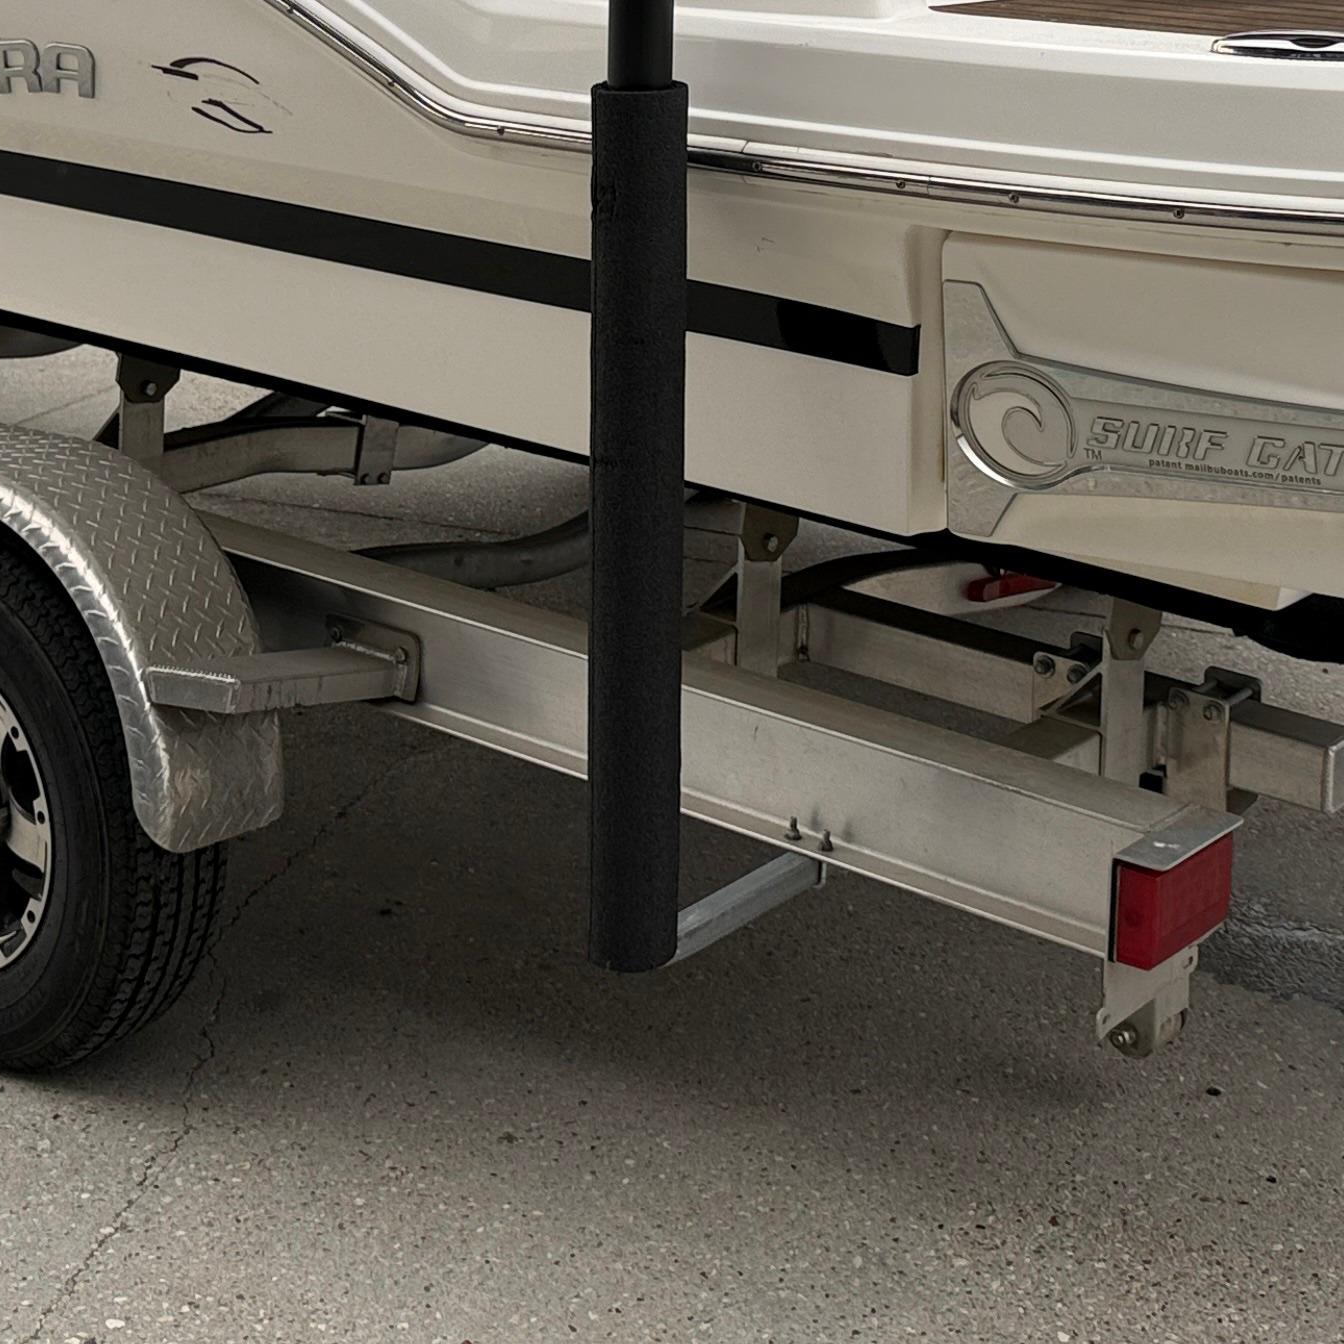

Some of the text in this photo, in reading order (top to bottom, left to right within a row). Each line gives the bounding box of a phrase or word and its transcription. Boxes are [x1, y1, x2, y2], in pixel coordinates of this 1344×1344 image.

[1087, 416, 1229, 461] SURF
[1083, 447, 1103, 461] TM
[1148, 458, 1183, 470] patent
